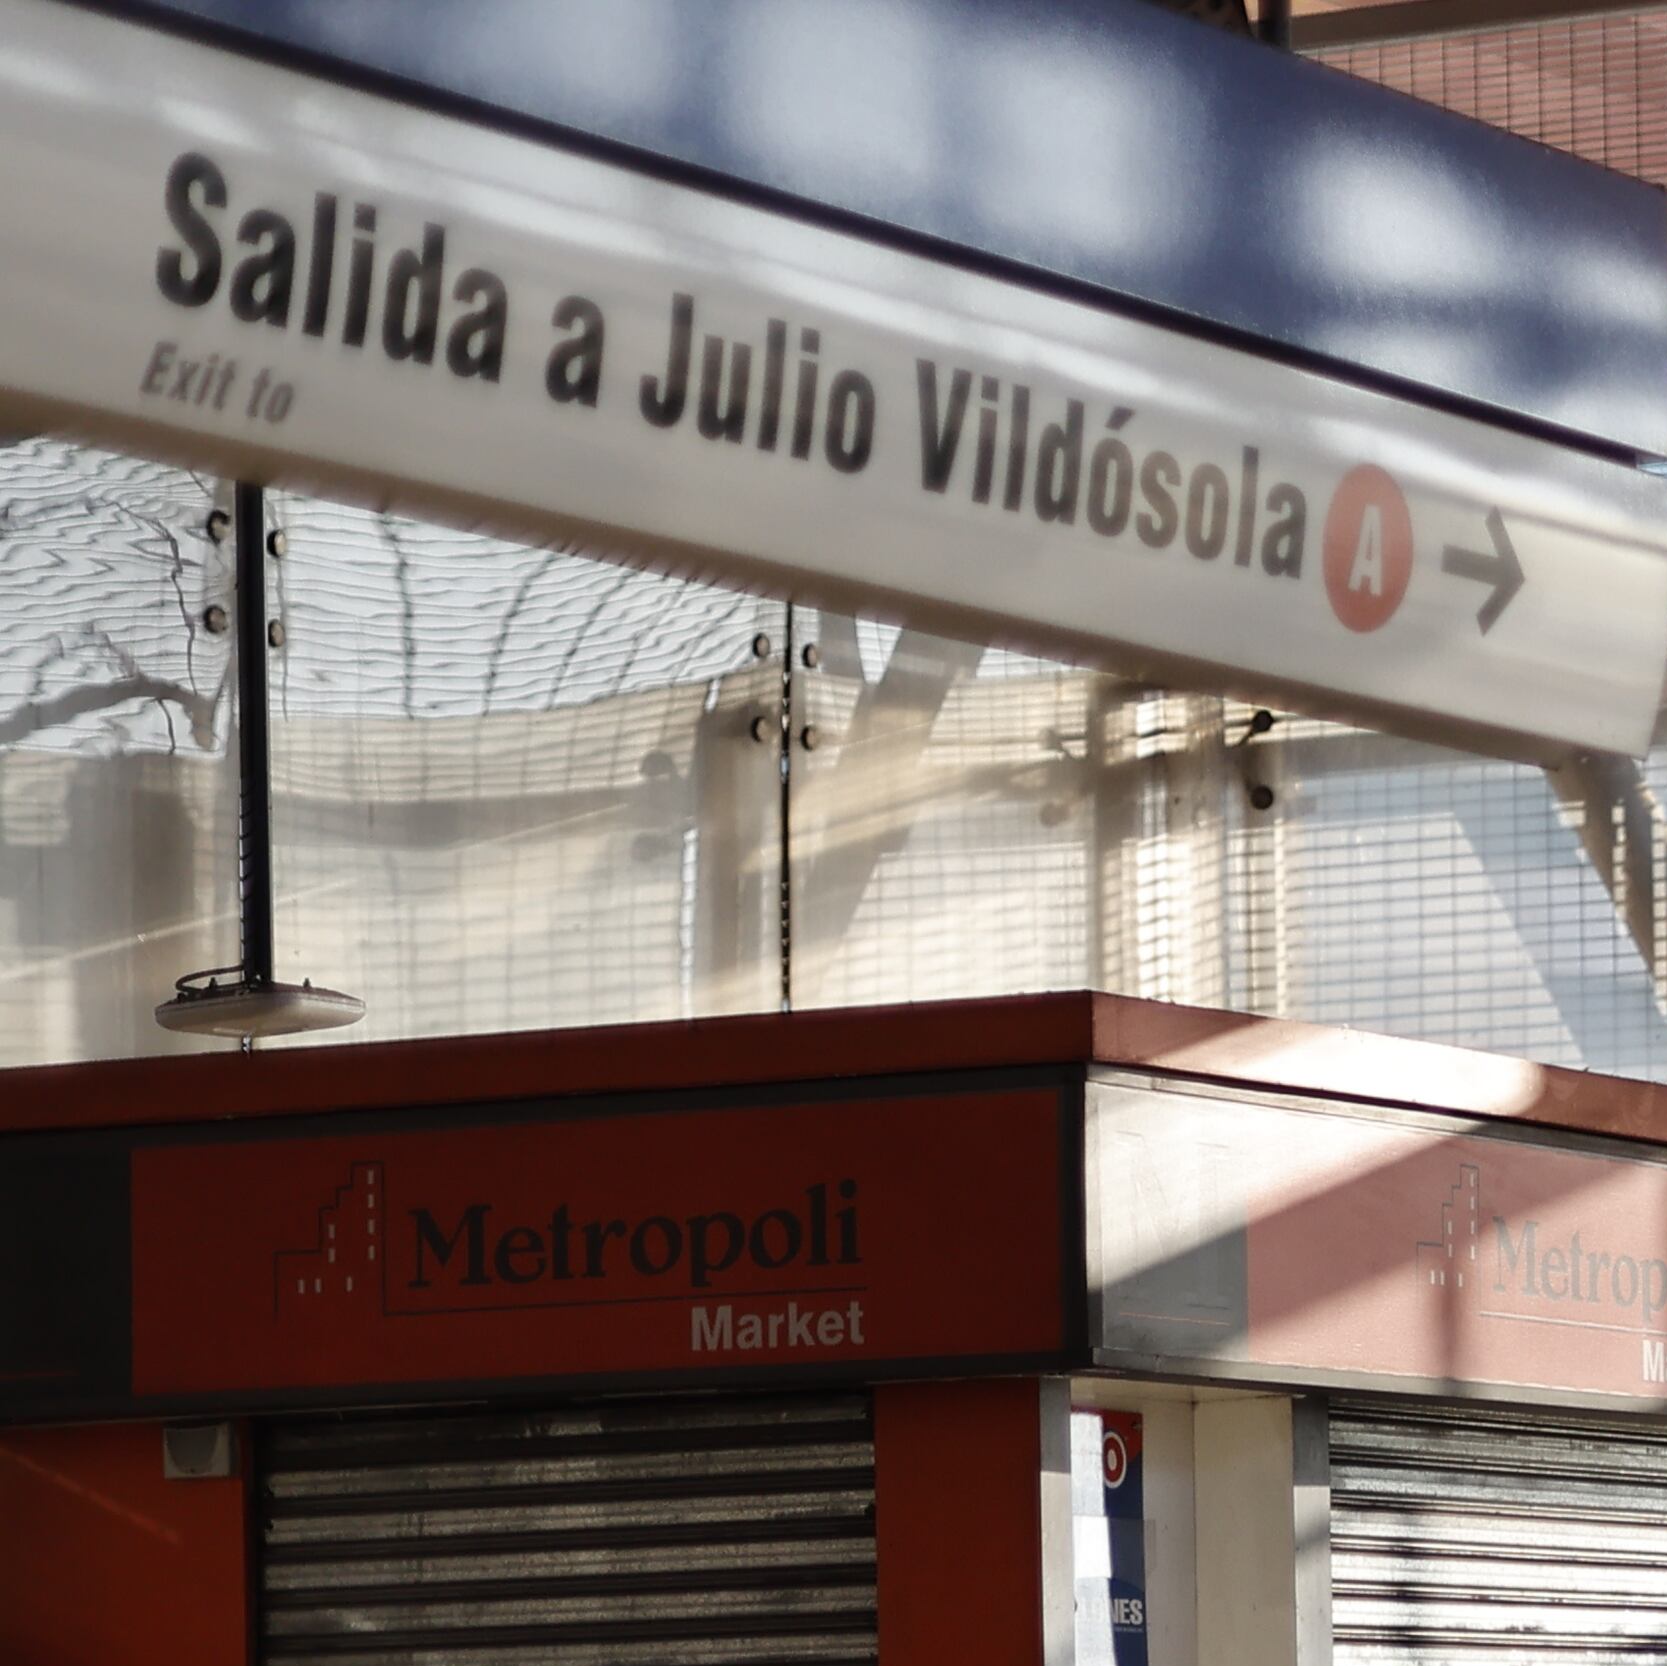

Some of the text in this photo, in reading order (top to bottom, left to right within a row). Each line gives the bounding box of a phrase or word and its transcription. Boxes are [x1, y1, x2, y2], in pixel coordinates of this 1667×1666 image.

[140, 341, 295, 424] Exit to
[155, 150, 1384, 598] Salida a Julio Vildósola A
[407, 1179, 863, 1289] Metropoli
[691, 1302, 865, 1351] Market
